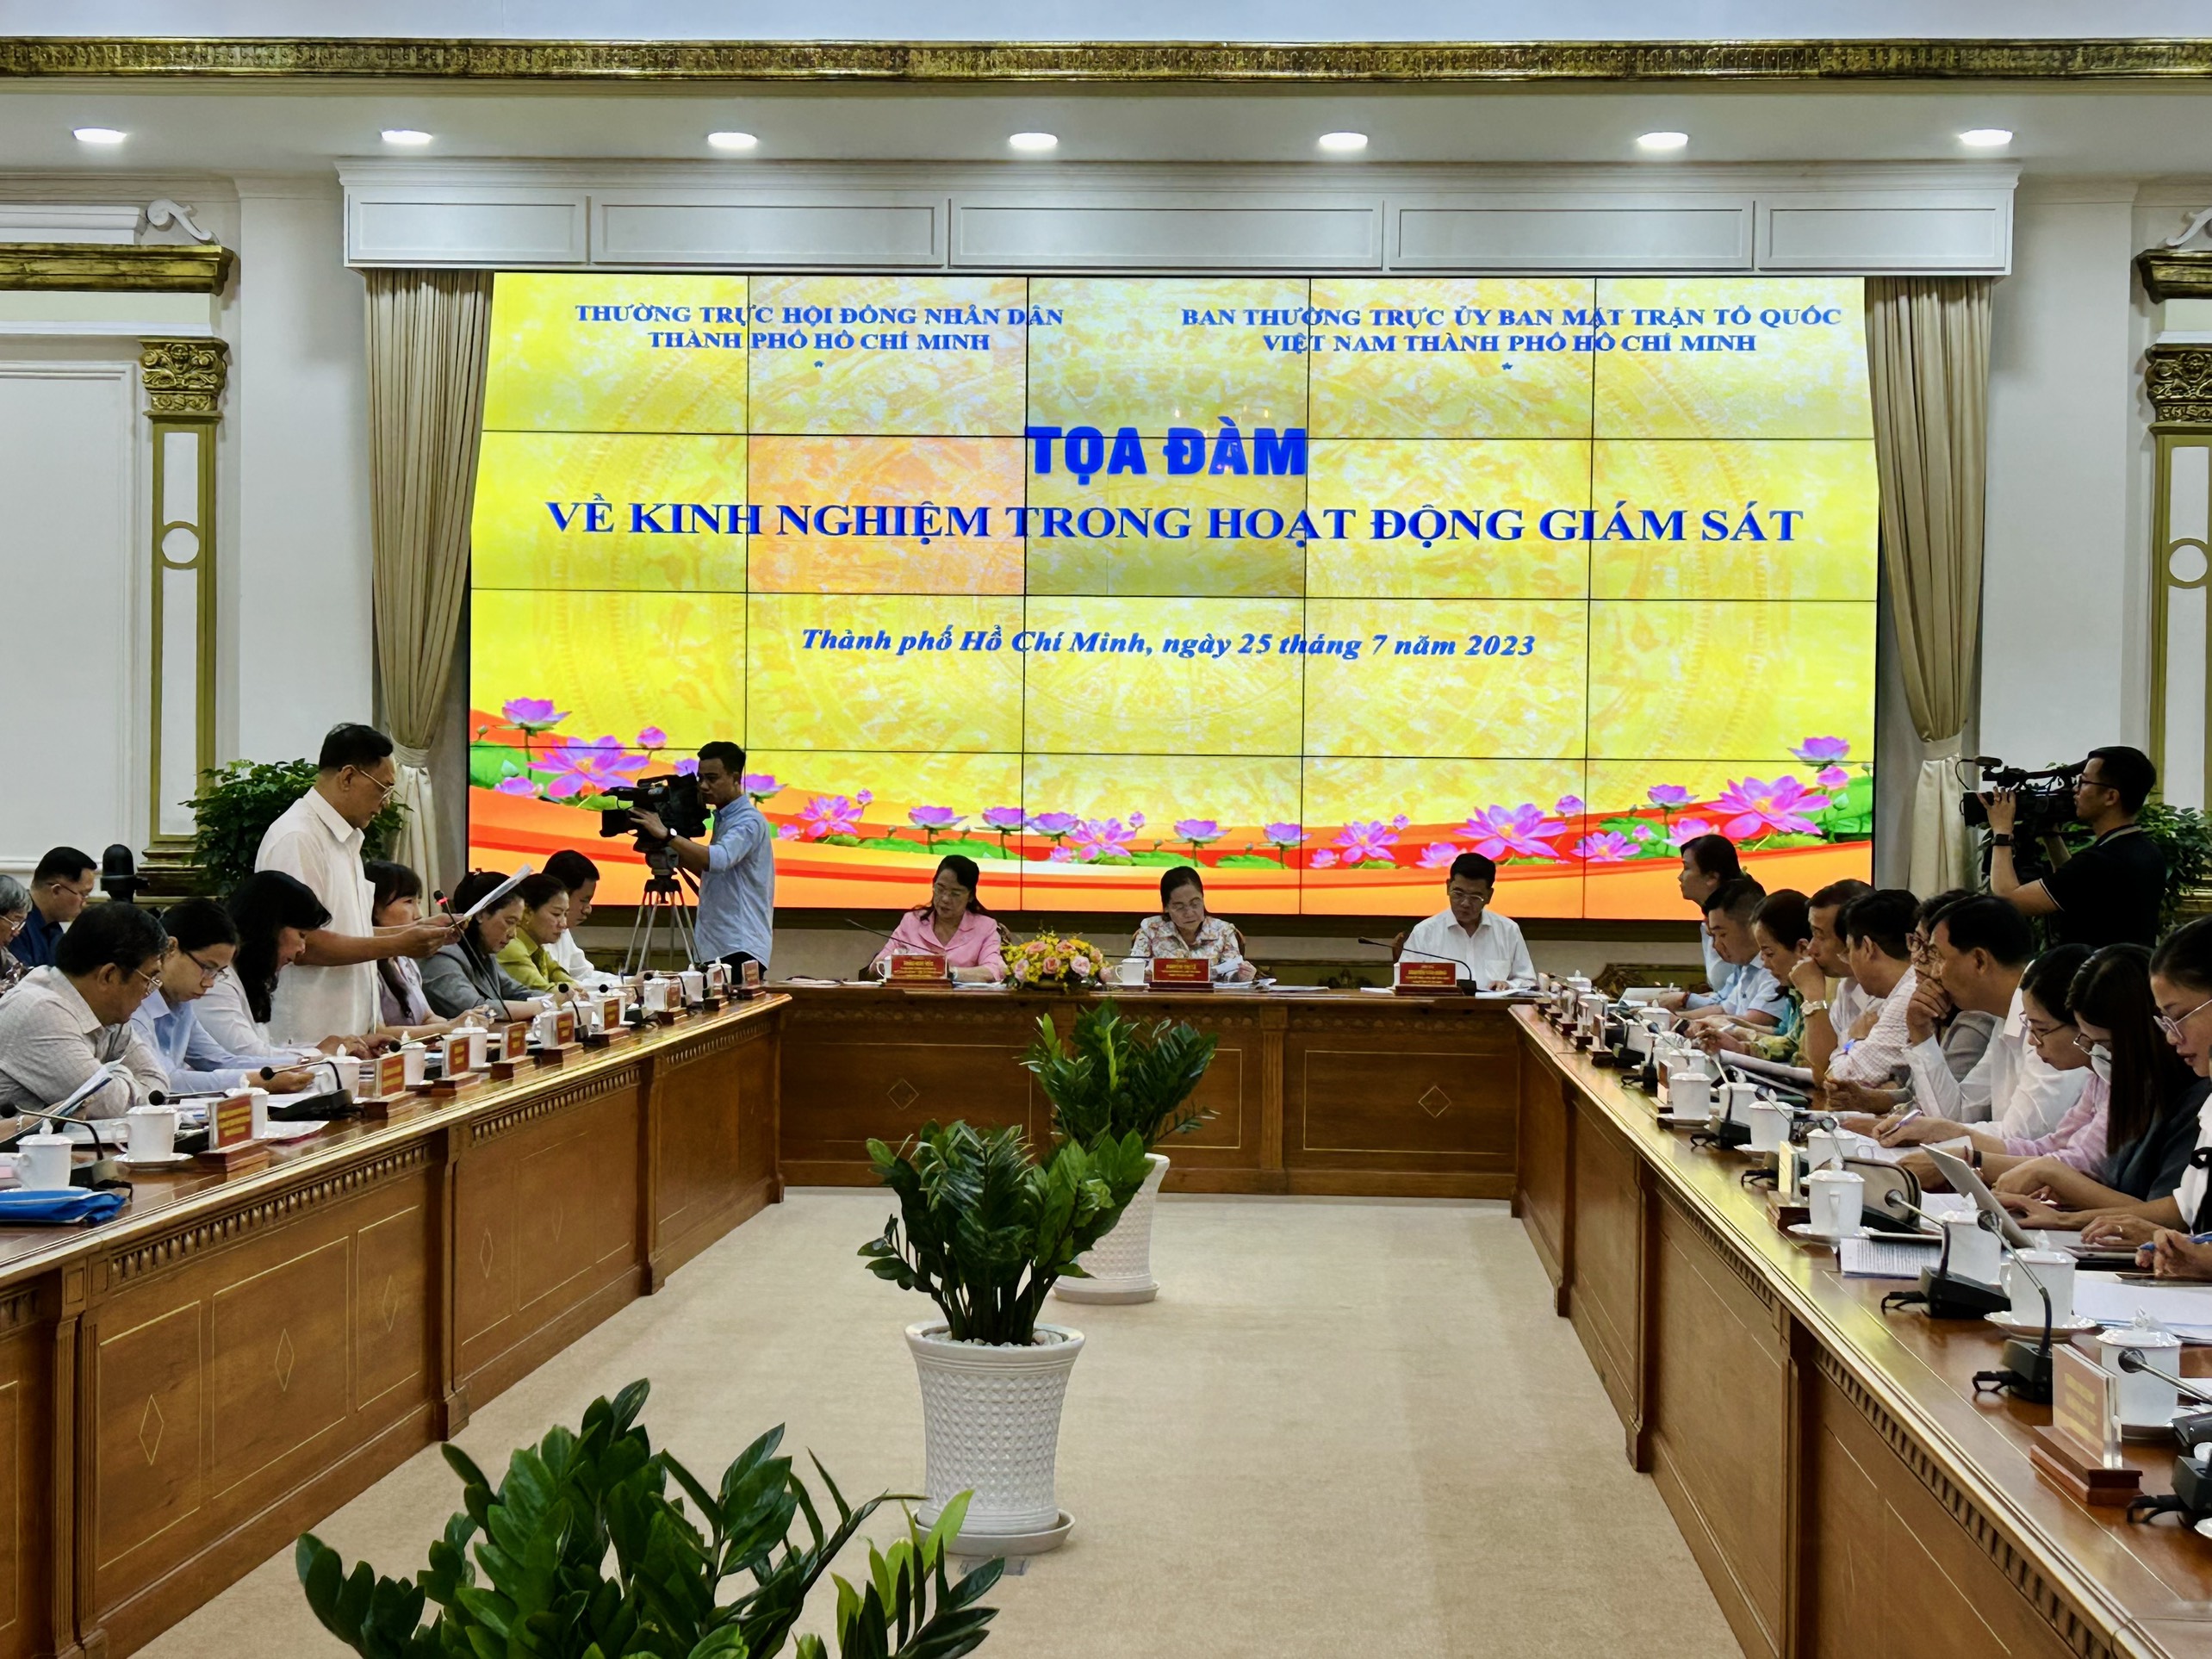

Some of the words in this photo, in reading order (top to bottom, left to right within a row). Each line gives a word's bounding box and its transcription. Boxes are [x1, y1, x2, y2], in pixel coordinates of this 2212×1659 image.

[575, 302, 692, 322] THƯỜNG
[699, 304, 774, 326] TRỰC
[782, 305, 833, 327] HỘI
[1181, 308, 1236, 326] BAN
[1245, 306, 1361, 326] THƯỜNG
[1369, 307, 1445, 329] TRỰC
[1497, 308, 1555, 326] BAN
[648, 328, 743, 349] THÀNH
[916, 333, 991, 351] MINH
[1263, 332, 1326, 354] VIỆT
[1333, 334, 1396, 351] NAM
[1403, 332, 1501, 351] THÀNH
[1680, 334, 1757, 351] MINH
[1024, 426, 1147, 486] TỌA
[1163, 415, 1307, 476] ĐÀM
[545, 492, 614, 534] VỀ
[627, 502, 766, 536] KINH
[776, 500, 992, 545] NGHIỆM
[1005, 506, 1191, 539] TRONG
[1205, 507, 1357, 548] HOẠT
[1370, 504, 1525, 549] ĐỘNG
[1538, 500, 1687, 541] GIÁM
[1701, 500, 1805, 541] SÁT
[802, 629, 892, 650] Thành
[896, 624, 953, 656] phố
[959, 625, 1003, 652] Hồ
[1011, 630, 1063, 652] Chí
[1066, 631, 1153, 656] Minh,
[1161, 632, 1233, 658] ngày
[1237, 633, 1273, 654] 25
[1277, 634, 1364, 660] tháng
[1371, 634, 1389, 656] 7
[1394, 635, 1457, 656] năm
[1463, 634, 1536, 656] 2023
